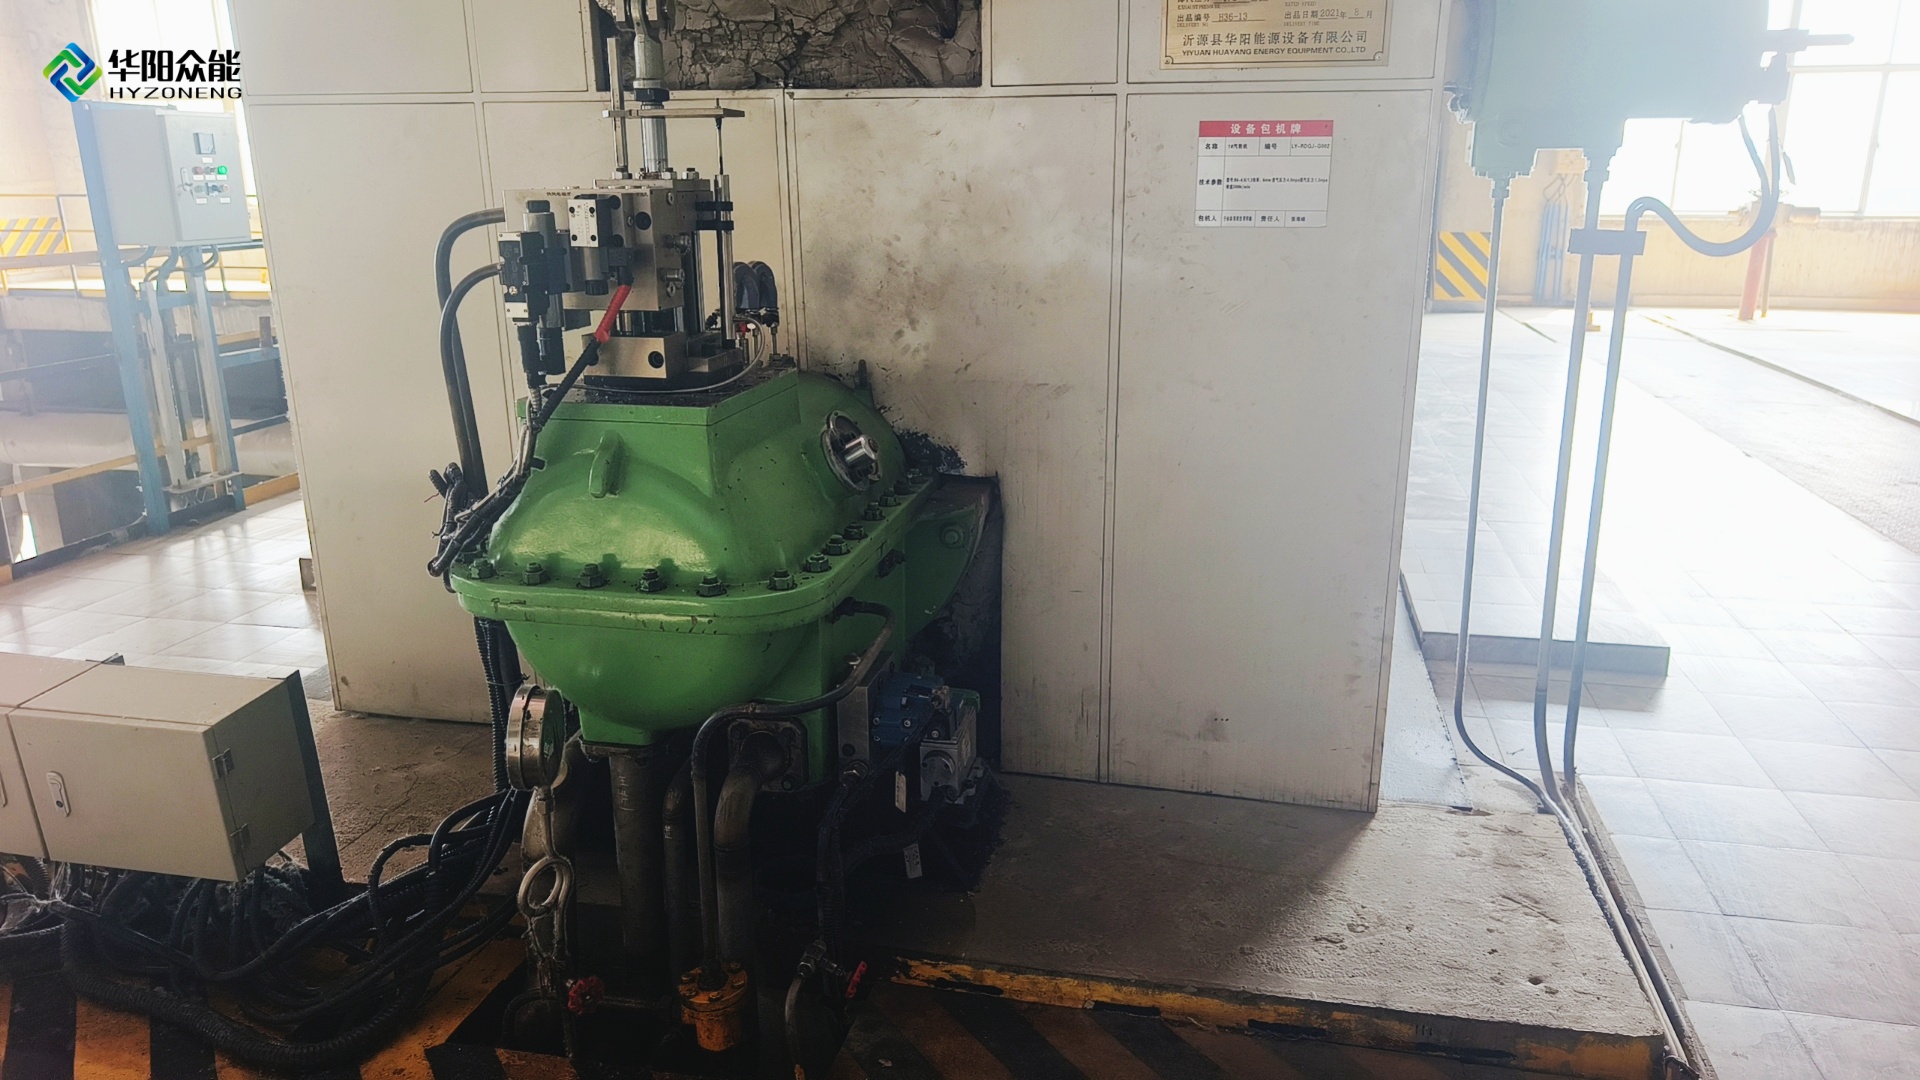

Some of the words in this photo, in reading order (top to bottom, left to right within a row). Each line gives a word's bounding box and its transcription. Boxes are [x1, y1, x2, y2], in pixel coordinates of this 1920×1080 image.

[1177, 13, 1210, 22] 出品编号
[1218, 12, 1248, 22] H36-13
[1182, 30, 1367, 47] 沂源县华阳能源设备有限公司
[1212, 48, 1252, 56] HUAYANG
[1230, 123, 1302, 135] 设备包机牌
[1198, 214, 1217, 222] 包机人
